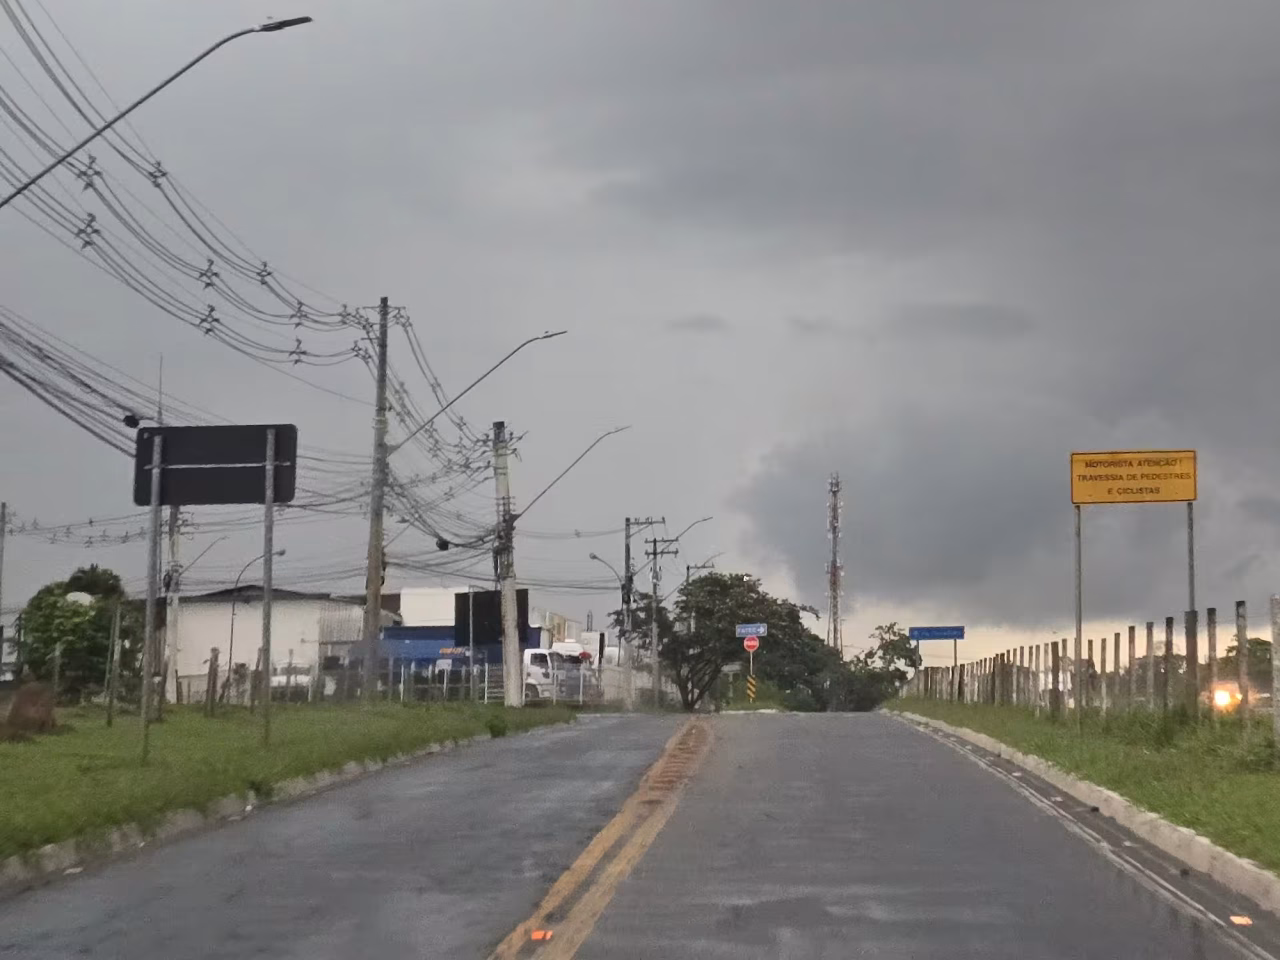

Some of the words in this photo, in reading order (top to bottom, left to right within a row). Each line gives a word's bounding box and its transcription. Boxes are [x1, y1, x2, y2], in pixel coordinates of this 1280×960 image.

[1085, 460, 1134, 468] MOTORISTA
[1076, 474, 1124, 482] TRAVESSIA
[1140, 472, 1192, 480] PEDESTRES
[1107, 487, 1114, 495] E
